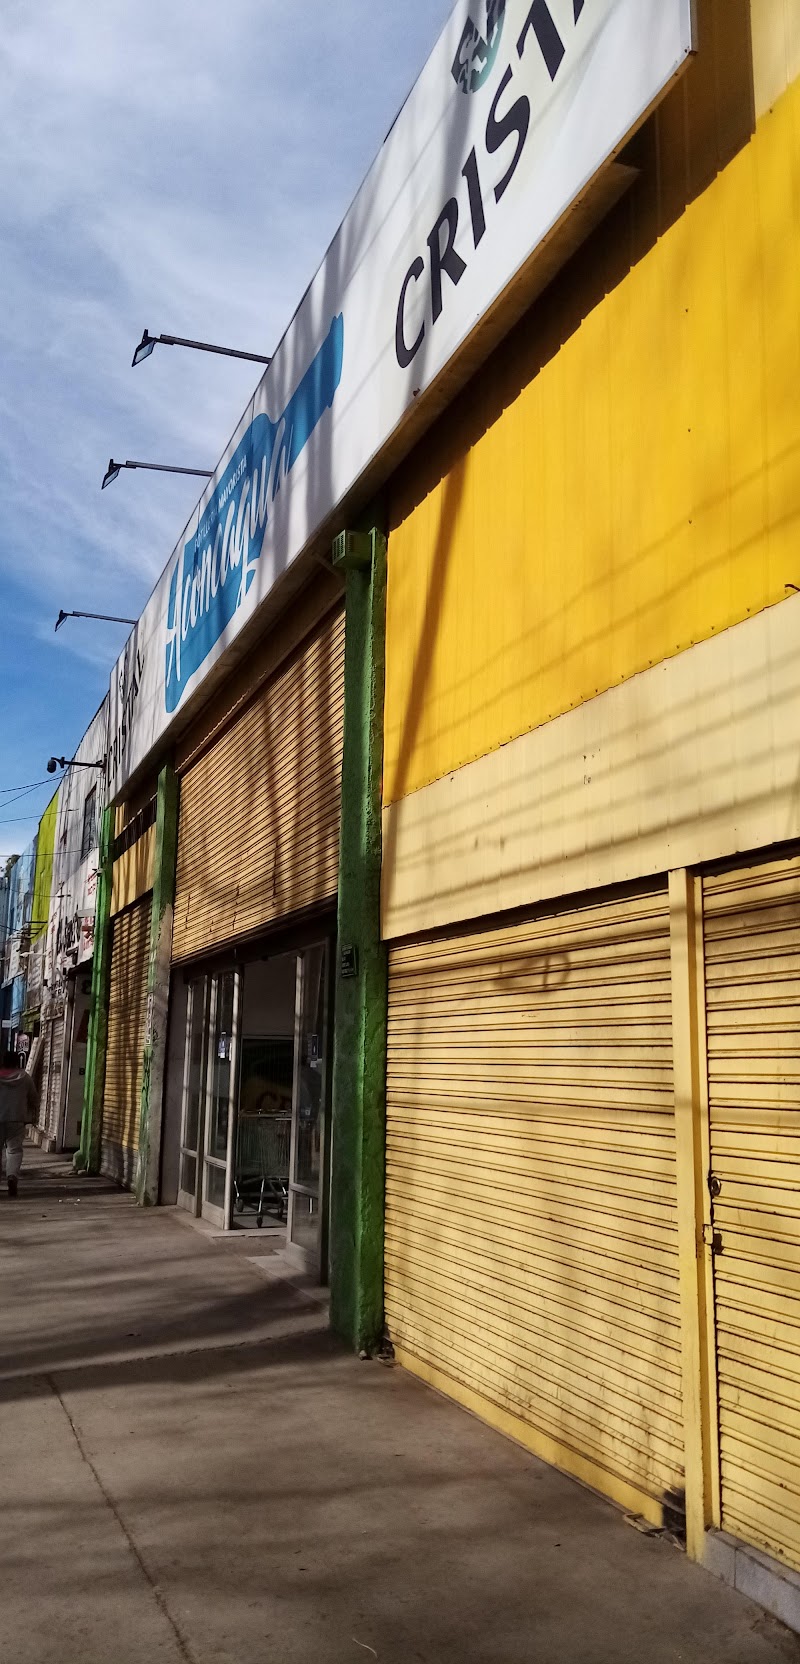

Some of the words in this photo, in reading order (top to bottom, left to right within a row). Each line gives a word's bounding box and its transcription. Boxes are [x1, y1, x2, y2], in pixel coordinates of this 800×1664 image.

[396, 0, 584, 369] CRIST
[165, 417, 294, 688] Aconcagua
[107, 649, 145, 788] CRISTAL
